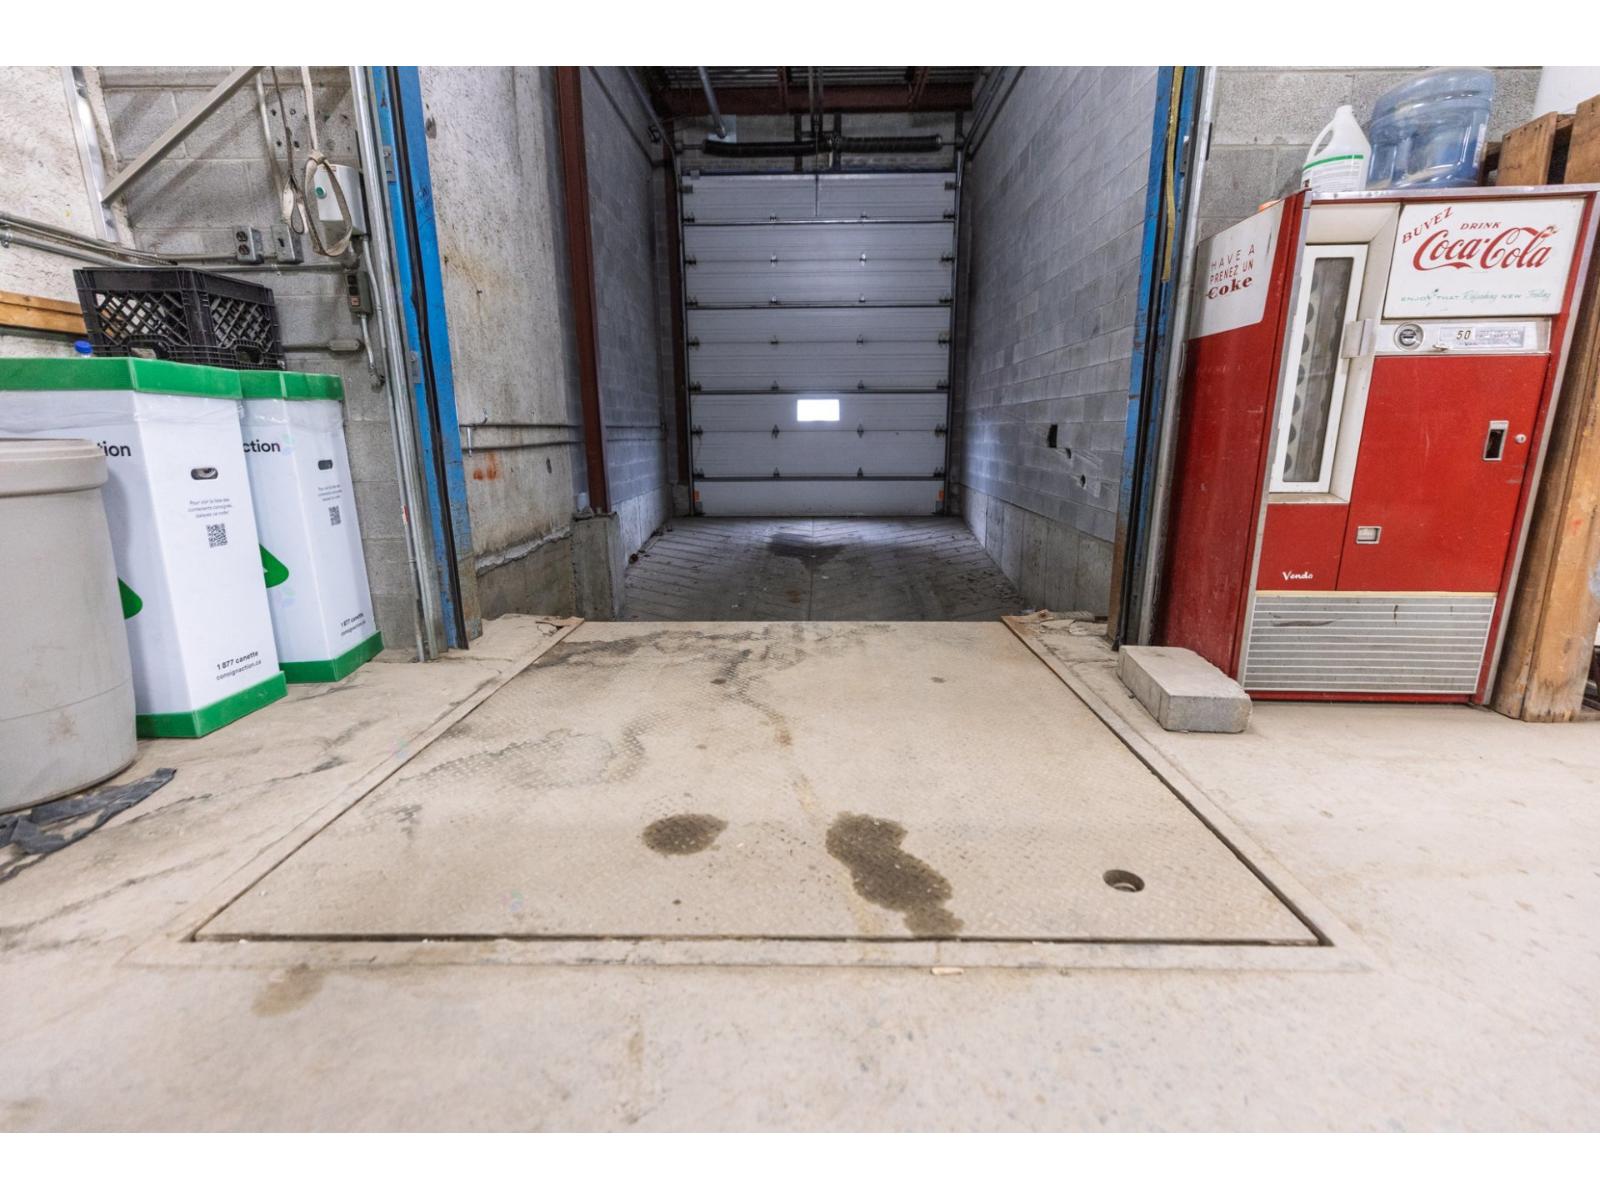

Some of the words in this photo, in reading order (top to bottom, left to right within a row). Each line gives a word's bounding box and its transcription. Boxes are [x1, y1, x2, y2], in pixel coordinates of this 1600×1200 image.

[1402, 206, 1453, 244] BUVEZ
[1460, 221, 1502, 230] DRINK
[1210, 249, 1242, 269] HAVE
[1248, 243, 1255, 256] A
[1412, 224, 1557, 271] Coca-Cola
[1209, 264, 1239, 284] PRENEZ
[1242, 258, 1254, 273] UN
[1205, 276, 1253, 300] Coke
[1456, 330, 1471, 341] 50
[97, 440, 132, 456] ion
[243, 438, 281, 453] ction
[1282, 571, 1314, 581] Vendo
[222, 659, 234, 669] 877
[235, 651, 259, 664] canette
